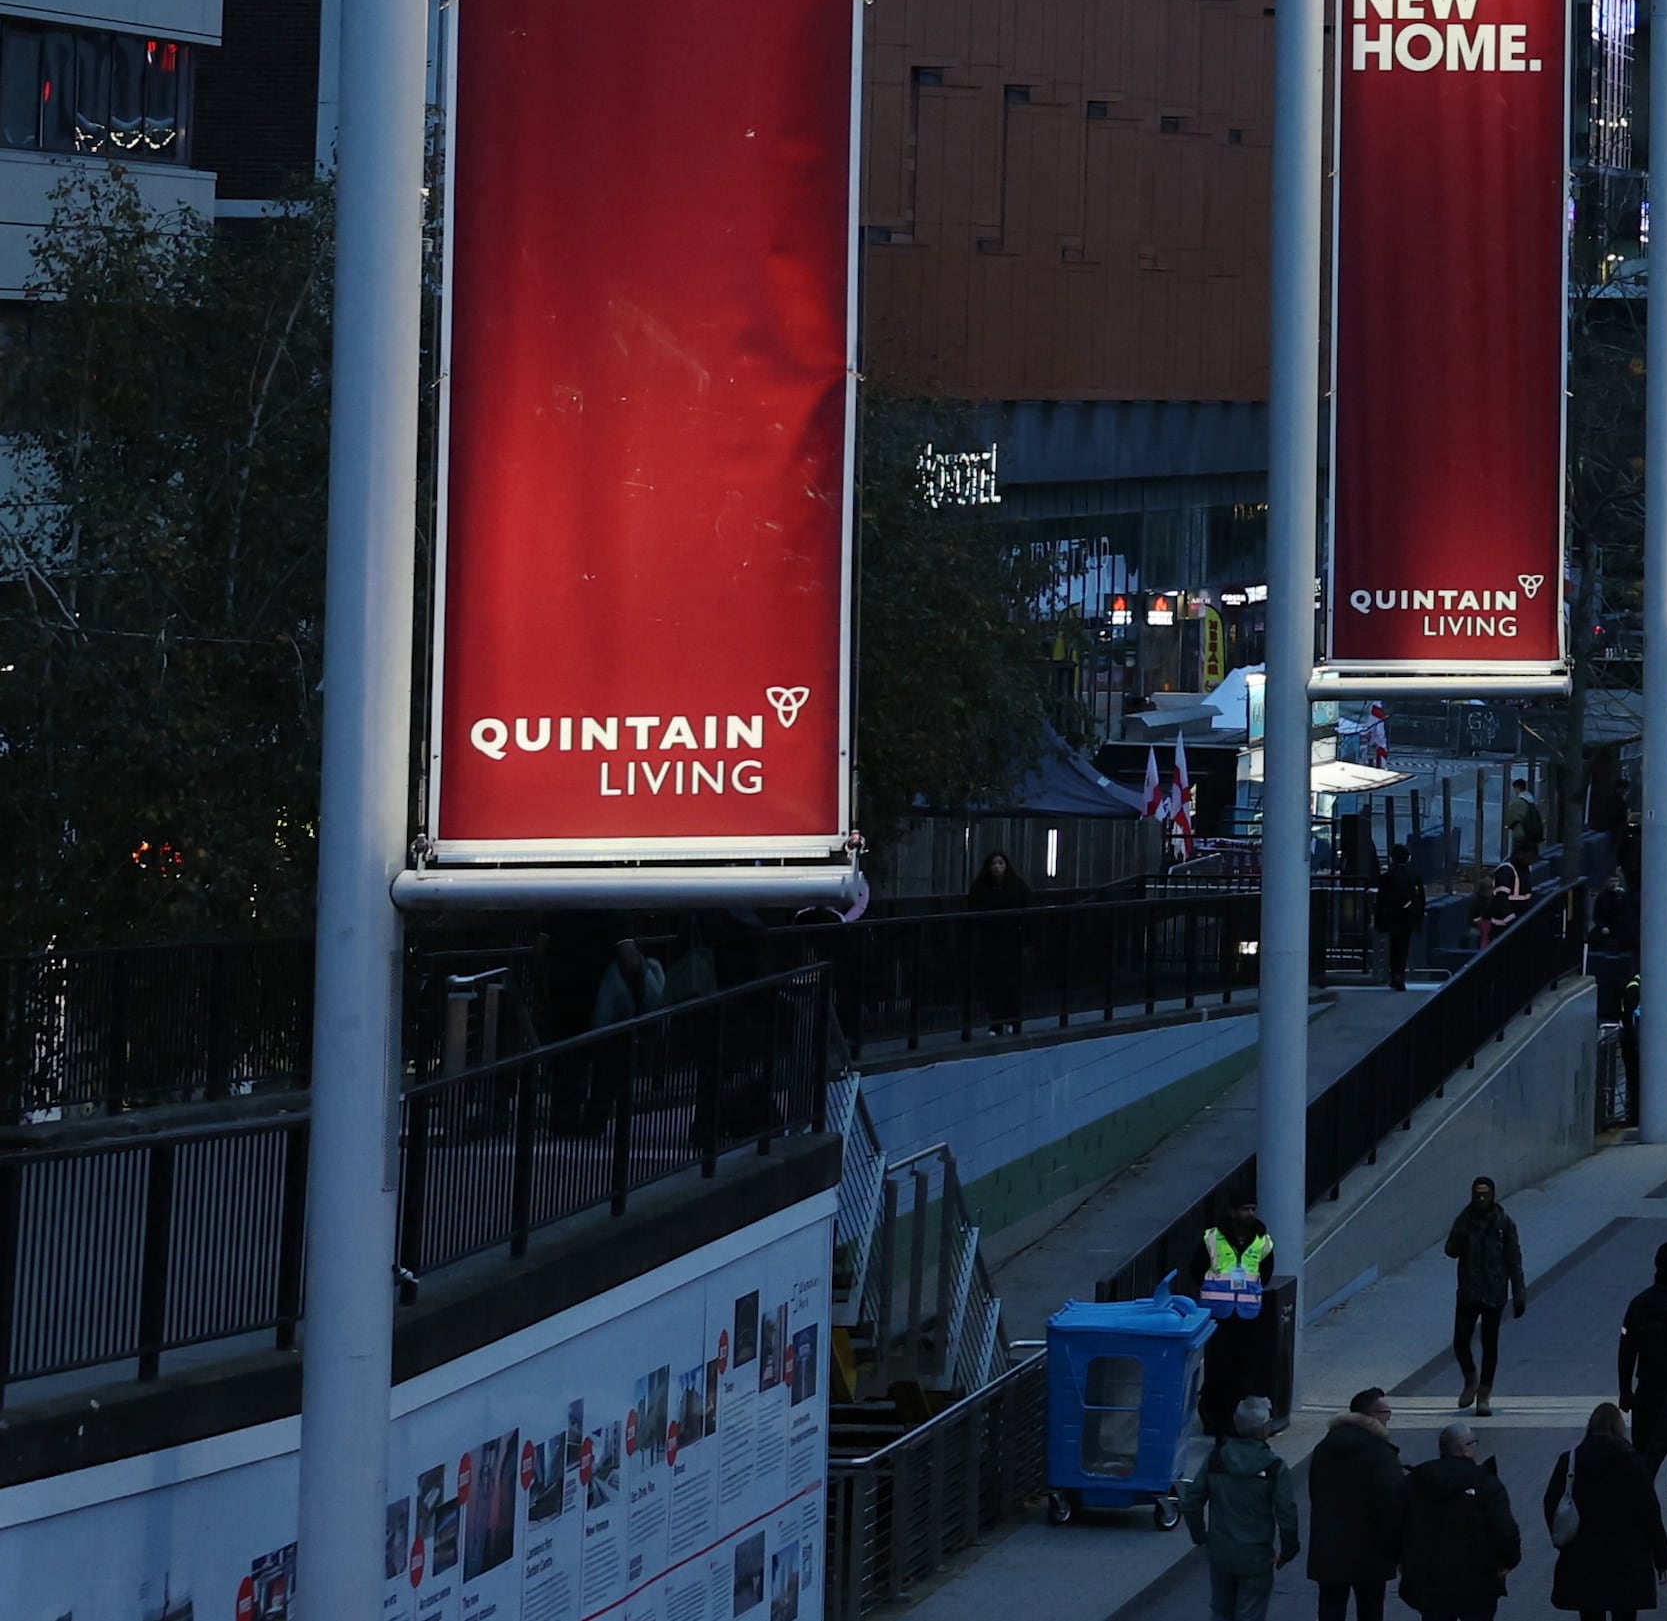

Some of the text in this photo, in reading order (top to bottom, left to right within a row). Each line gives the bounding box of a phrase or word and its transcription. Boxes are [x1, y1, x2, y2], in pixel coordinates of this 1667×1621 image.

[1352, 24, 1542, 72] HOME.
[1350, 589, 1517, 614] QUINTAIN
[1423, 616, 1518, 638] LIVING
[470, 715, 763, 760] QUINTAIN
[601, 760, 764, 797] LIVING
